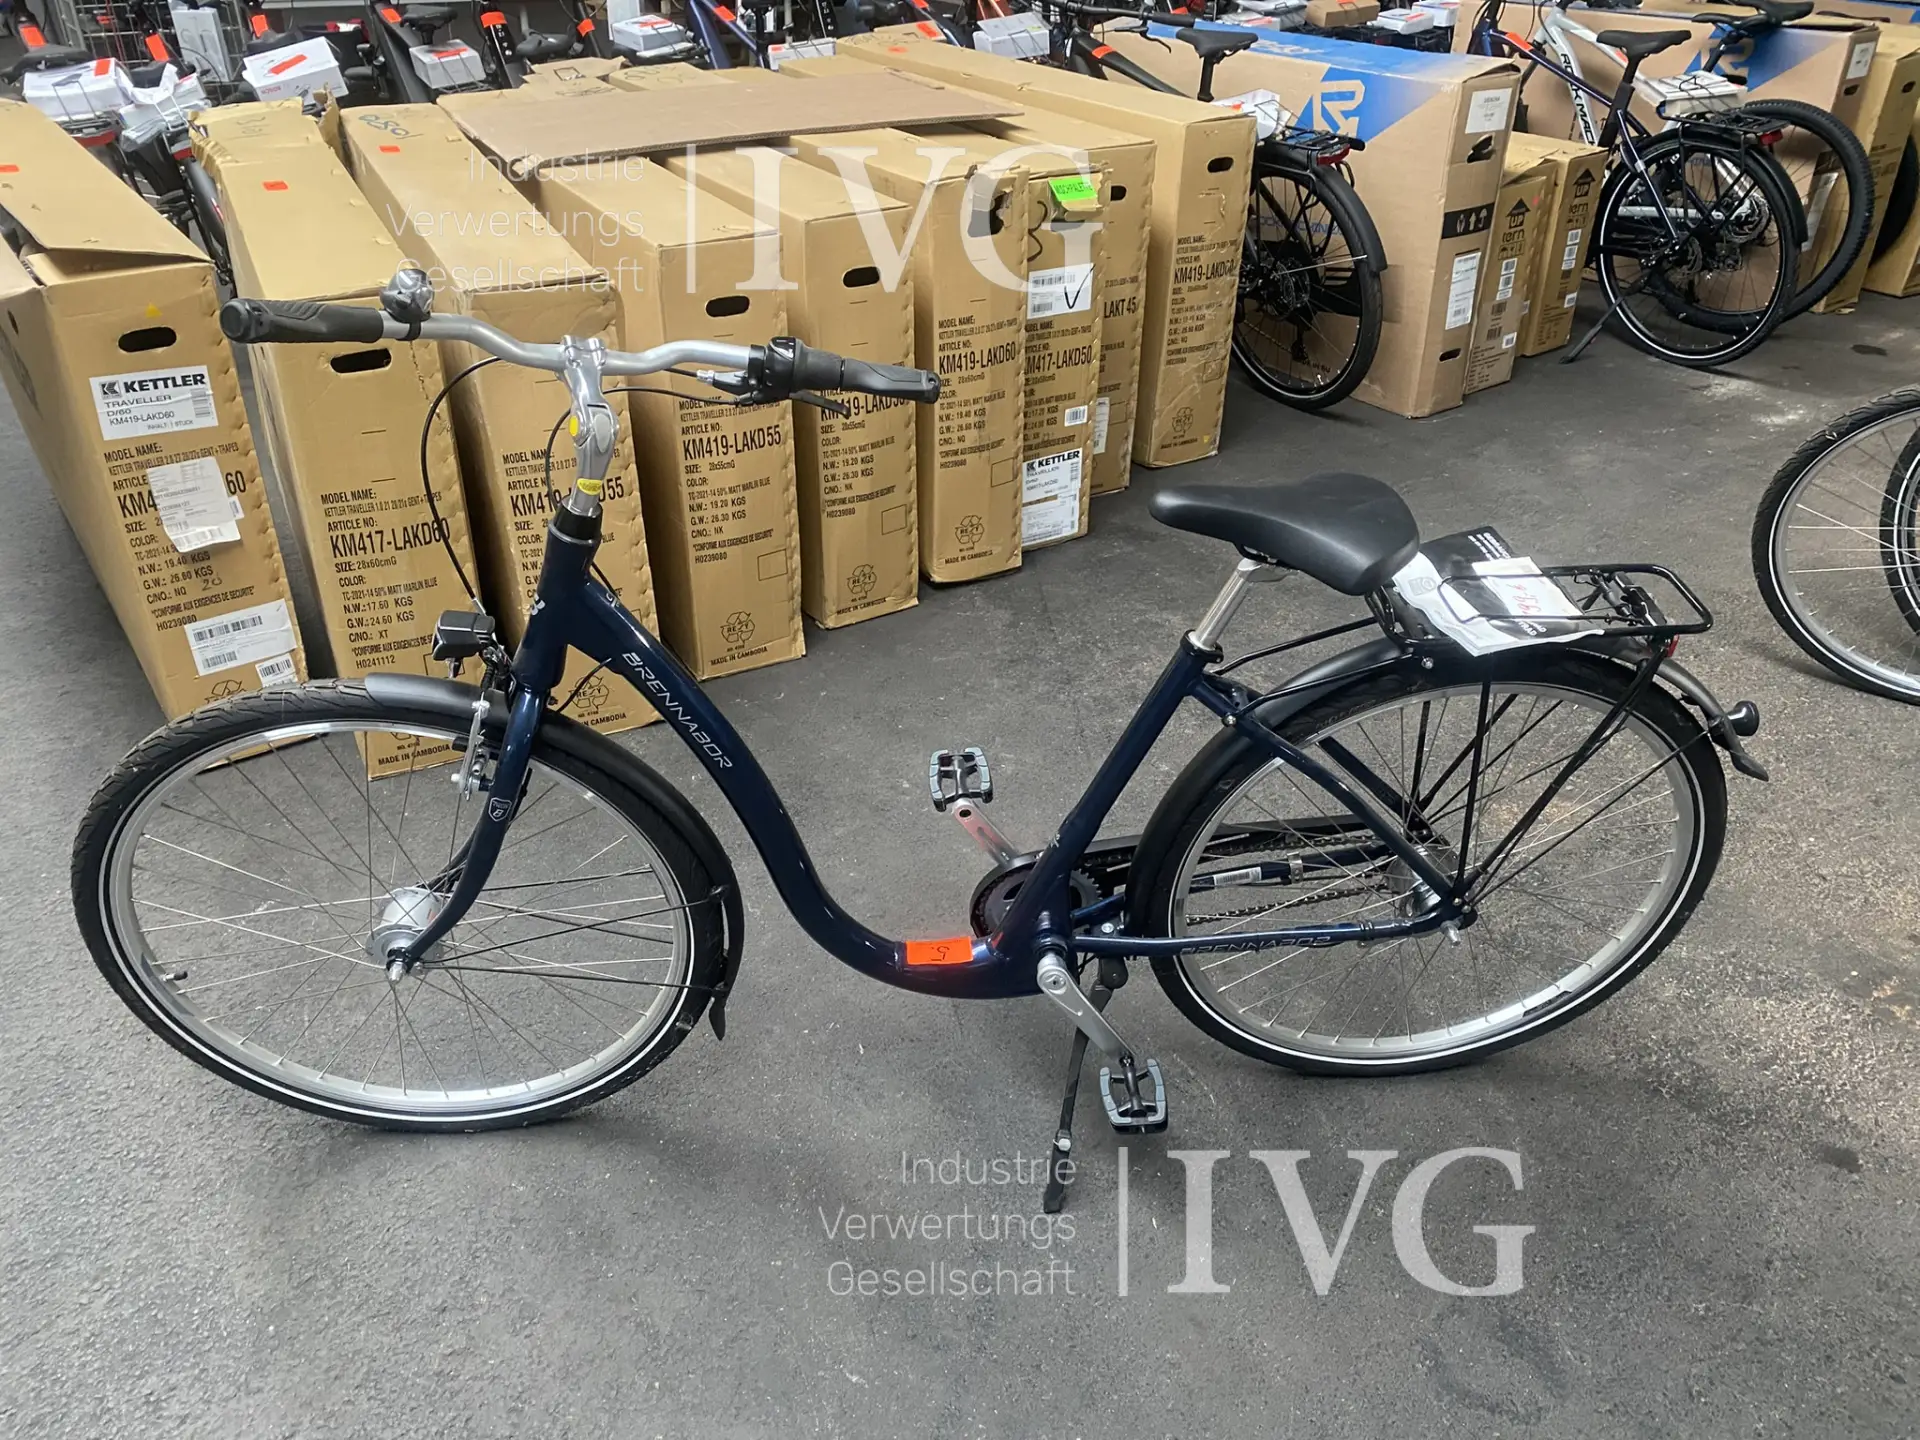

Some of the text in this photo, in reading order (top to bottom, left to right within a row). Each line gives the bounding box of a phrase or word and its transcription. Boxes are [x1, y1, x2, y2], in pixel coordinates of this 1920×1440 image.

[1509, 215, 1525, 228] UP
[939, 341, 1016, 375] KM419-LAKD60
[1025, 345, 1092, 375] M417-LAKD50
[124, 373, 206, 394] KETTLER
[104, 394, 172, 408] TRAVELLER
[106, 408, 131, 417] D/60
[109, 410, 175, 426] KM419-LAKD60
[681, 422, 723, 435] ARTICLE NO:
[683, 424, 782, 461] KM419-LAKD55
[104, 442, 163, 464] MODEL NAME:
[502, 452, 529, 465] MODEL
[861, 455, 874, 464] KGS
[1038, 450, 1080, 467] KETTLER
[108, 462, 133, 476] KETTLER
[134, 456, 165, 472] TRAVELLER
[505, 465, 527, 477] KETTLER
[685, 464, 702, 474] SIZE:
[861, 467, 874, 477] KGS
[113, 476, 148, 492] ARTICLE
[507, 479, 540, 491] ARTICLE
[686, 477, 709, 487] COLOR:
[320, 488, 377, 505] MODEL NAME:
[731, 496, 746, 506] KGS
[324, 505, 347, 518] KETTLER
[732, 509, 746, 520] KGS
[125, 520, 147, 534] SIZE:
[327, 517, 378, 532] ARTICLE NO:
[514, 520, 534, 531] SIZE:
[130, 535, 159, 548] COLOR:
[517, 534, 544, 545] COLOR:
[138, 551, 211, 576] N.W.: 19.40 KGS
[335, 556, 397, 573] SIZE: 28x60cmG
[143, 578, 167, 591] G.W.:
[194, 565, 214, 579] KGS
[339, 575, 367, 588] COLOR:
[342, 588, 374, 601] TC-2021-14
[387, 584, 403, 595] MATT
[424, 577, 438, 588] BLUE
[343, 602, 367, 614] N.W.:
[394, 596, 414, 608] KGS
[347, 617, 370, 629] G.W.:
[396, 611, 415, 622] KGS
[349, 630, 389, 643] C/NO.: XT
[355, 655, 396, 669] H0241112
[622, 652, 733, 769] BRENNABOR
[590, 713, 627, 726] CAMBODIA
[378, 744, 450, 765] MADE IN CAMBODIA
